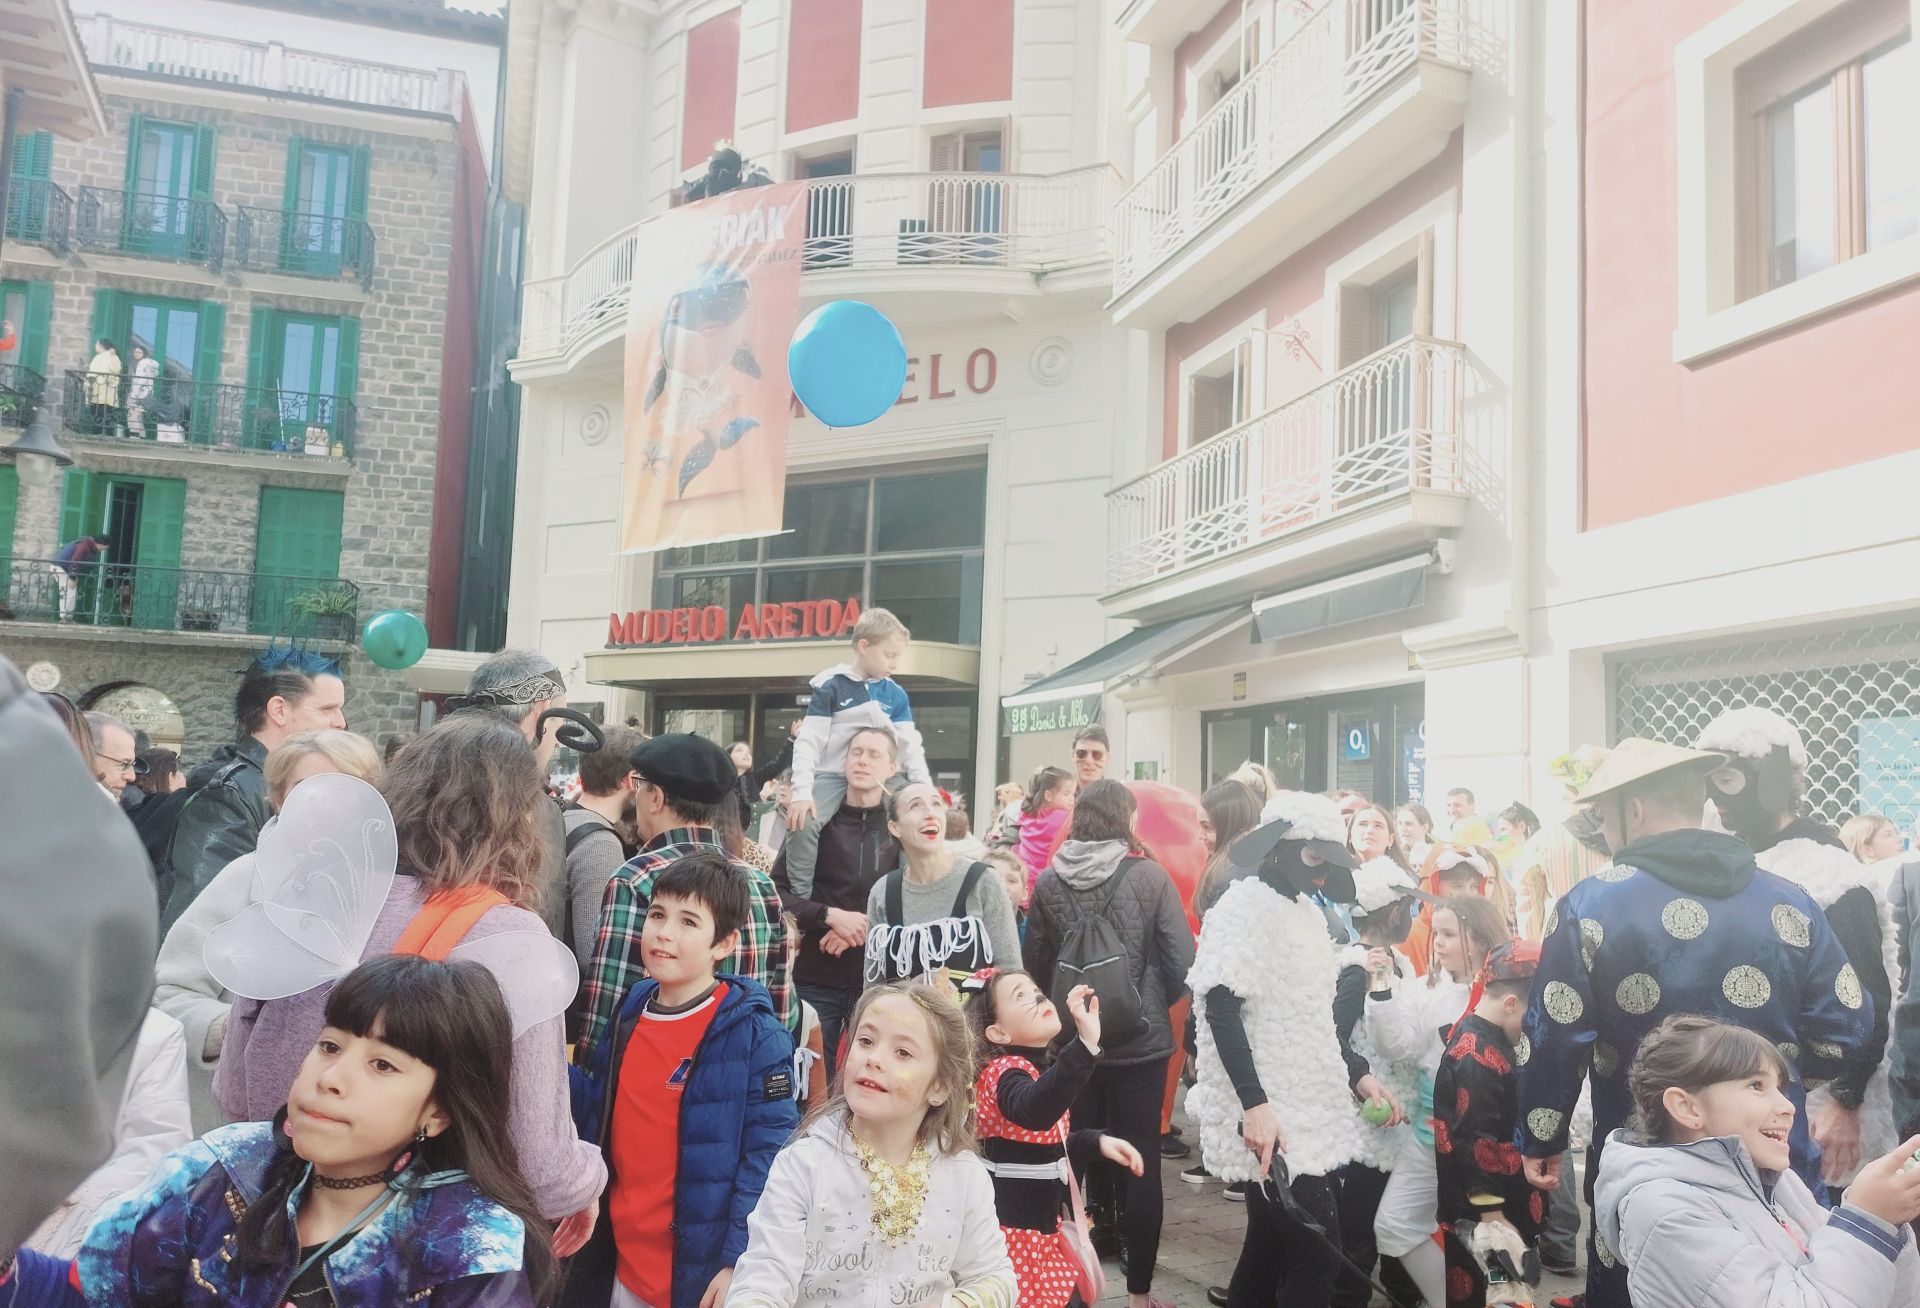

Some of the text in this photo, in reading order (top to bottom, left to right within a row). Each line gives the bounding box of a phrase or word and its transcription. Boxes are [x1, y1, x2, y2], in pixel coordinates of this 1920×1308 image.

[607, 597, 862, 645] MODELO ARETOA
[1031, 705, 1056, 732] David
[1058, 705, 1067, 728] &
